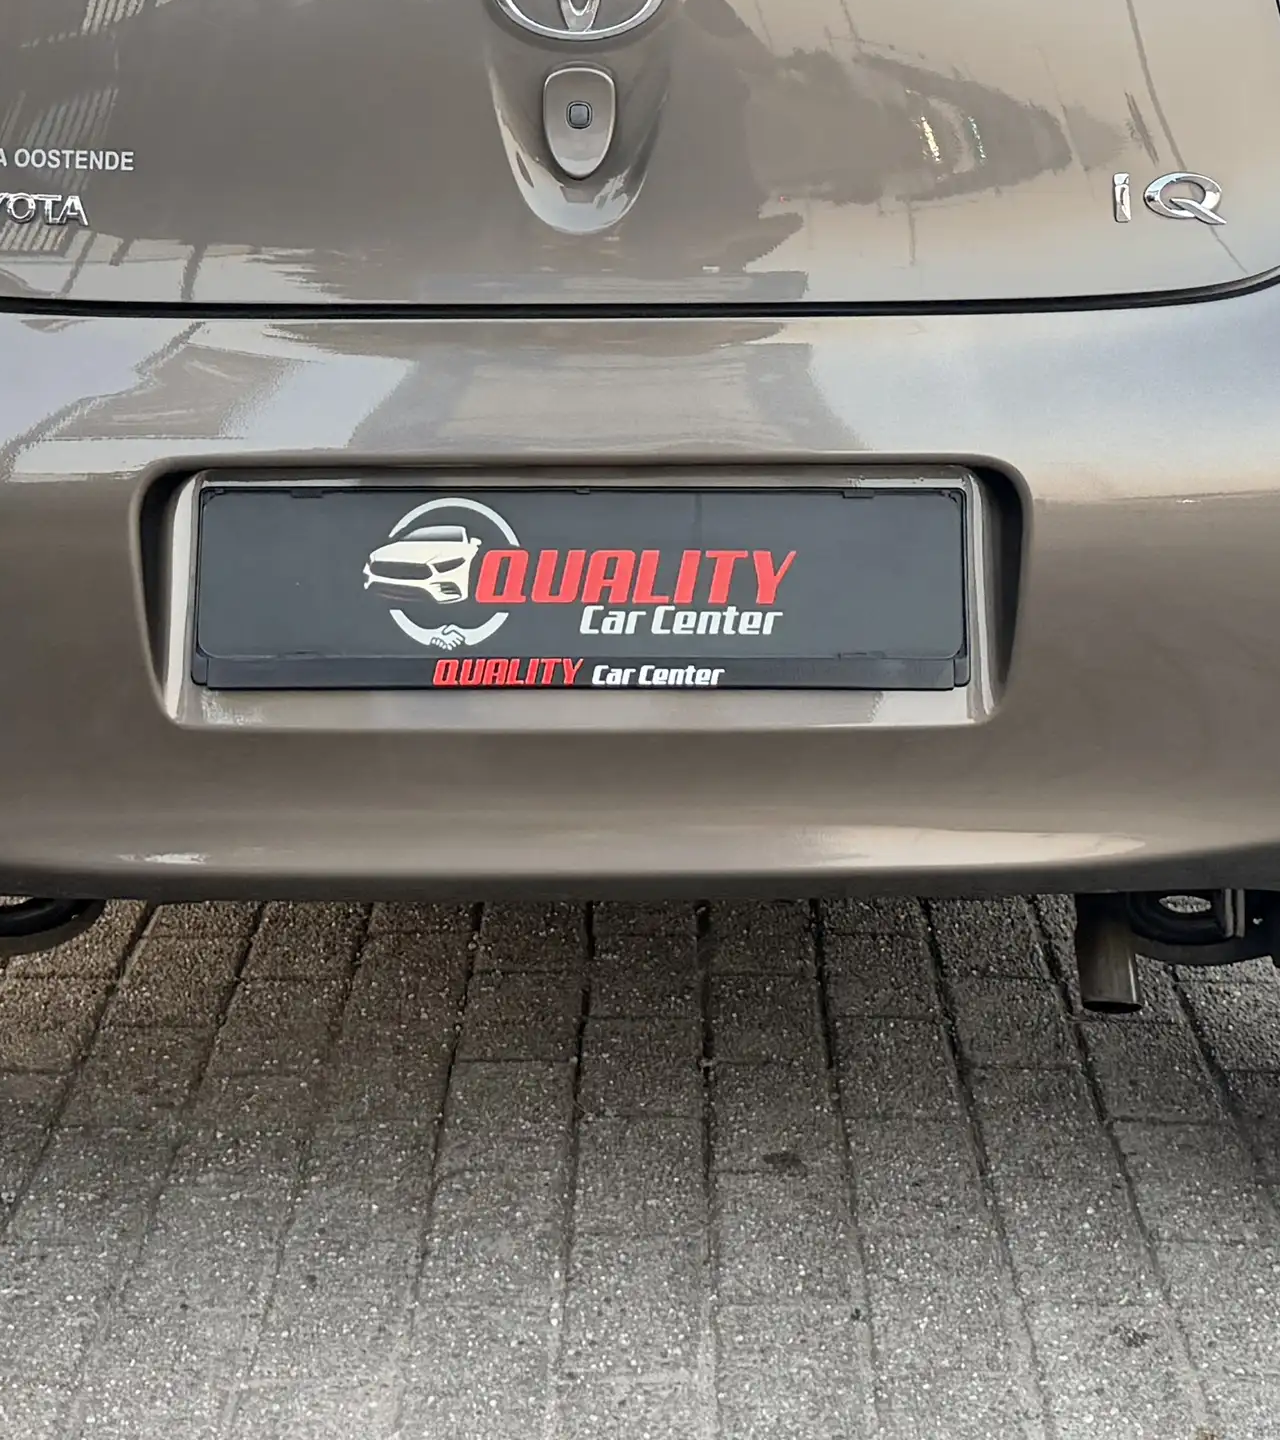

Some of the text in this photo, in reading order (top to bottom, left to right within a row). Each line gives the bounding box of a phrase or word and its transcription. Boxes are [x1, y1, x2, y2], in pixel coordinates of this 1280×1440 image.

[13, 148, 135, 172] OOSTENDE
[474, 549, 798, 605] QUALITY
[579, 604, 784, 636] Car Center
[432, 657, 726, 687] QUALITY Car Center
